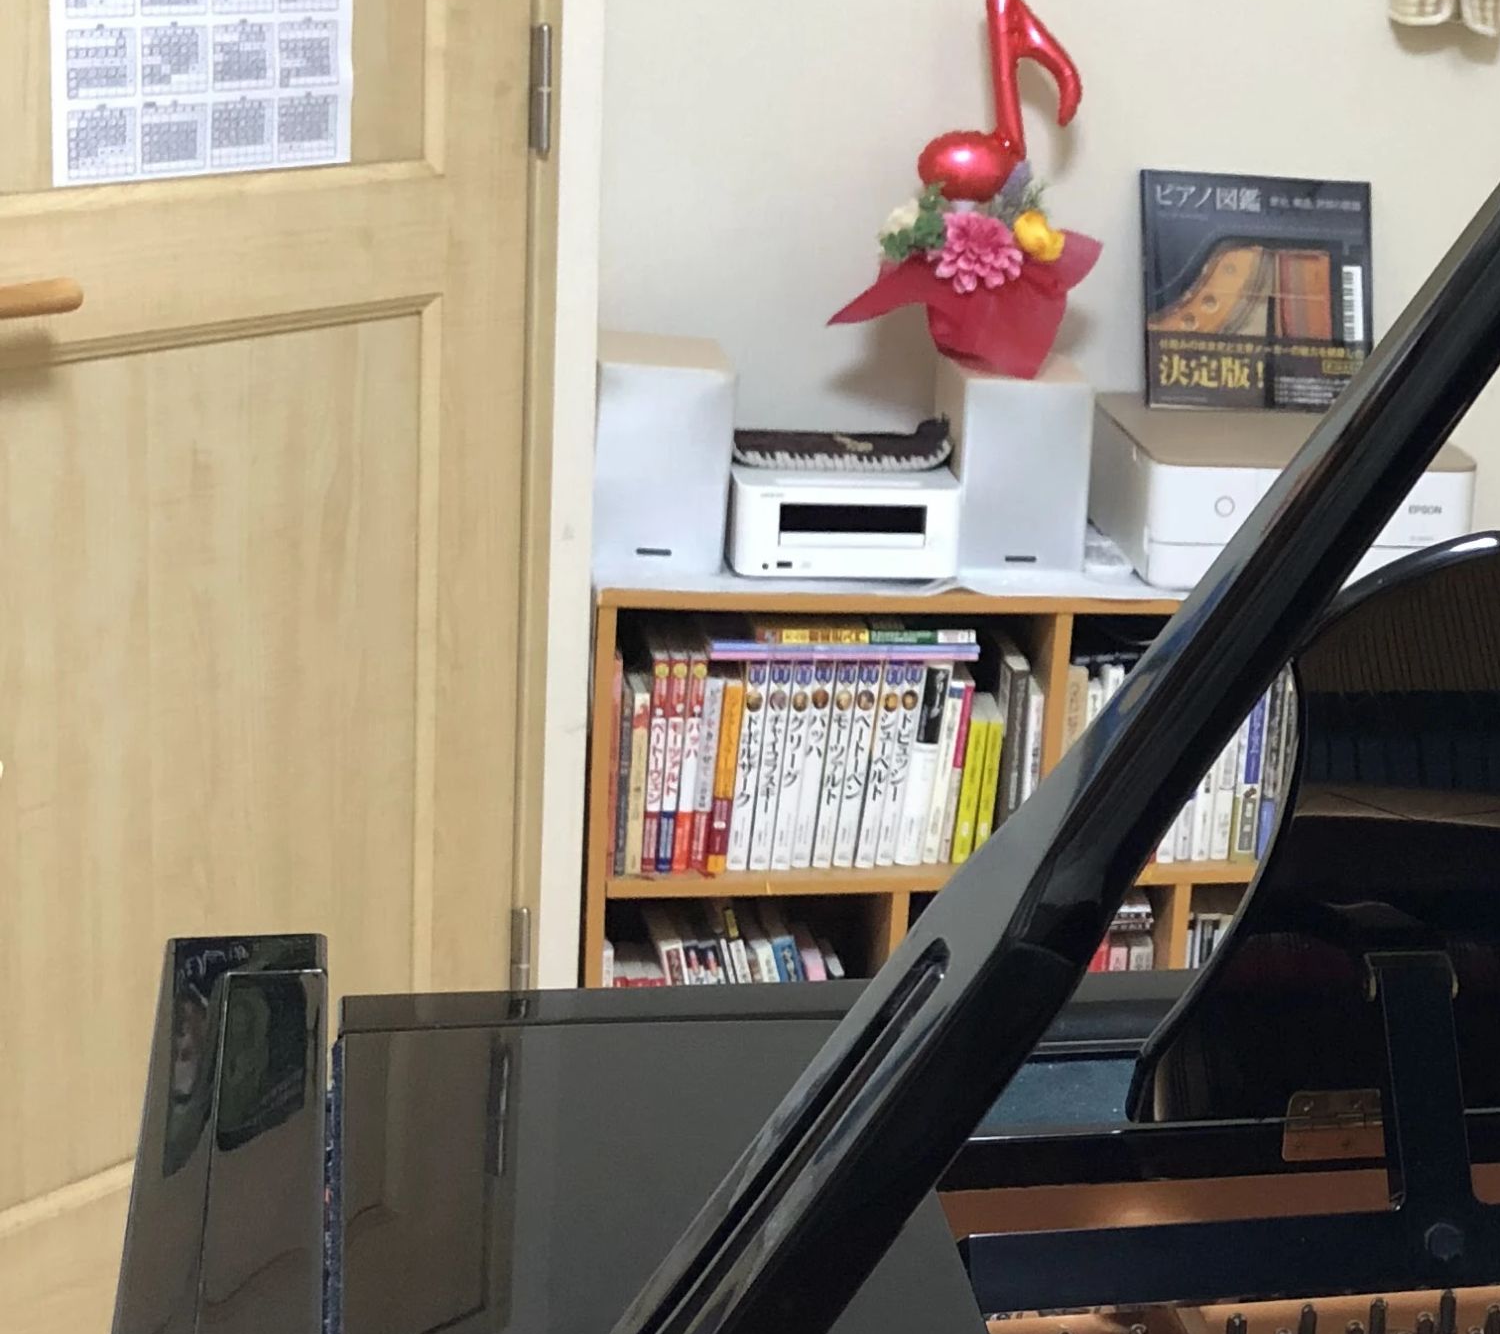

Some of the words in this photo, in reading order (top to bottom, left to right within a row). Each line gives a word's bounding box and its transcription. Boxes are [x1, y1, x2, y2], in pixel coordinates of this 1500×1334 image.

[1156, 184, 1261, 212] ピアノ図鑑
[1408, 504, 1442, 515] EPSON
[784, 714, 804, 787] グリーグ
[805, 714, 827, 758] バッハ
